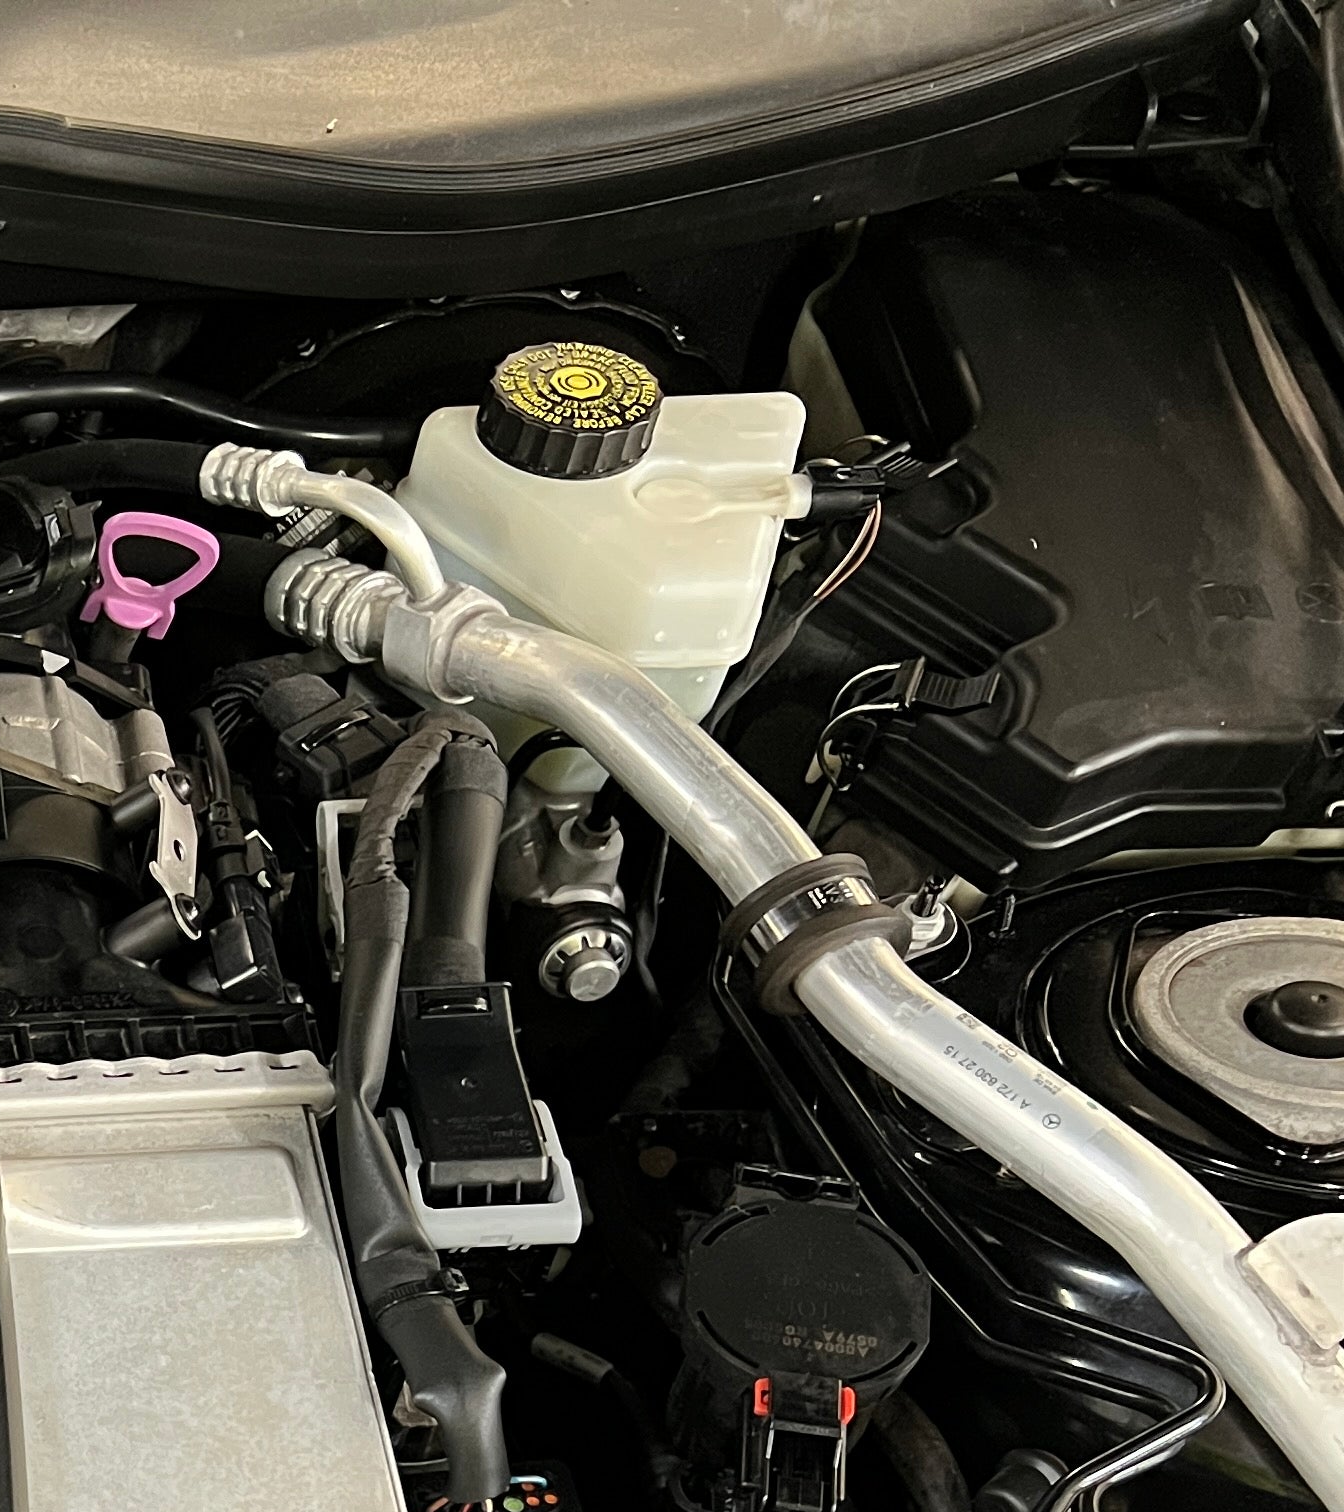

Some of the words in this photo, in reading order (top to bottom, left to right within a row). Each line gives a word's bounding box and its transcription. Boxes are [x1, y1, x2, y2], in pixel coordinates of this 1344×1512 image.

[527, 349, 552, 362] DOT
[554, 342, 616, 358] WARNING
[624, 405, 646, 421] CAP
[572, 415, 623, 429] BEFORE
[943, 1044, 959, 1060] 15
[958, 1056, 978, 1071] 27
[974, 1067, 1001, 1087] 830
[996, 1084, 1020, 1102] 172
[1019, 1100, 1032, 1110] A
